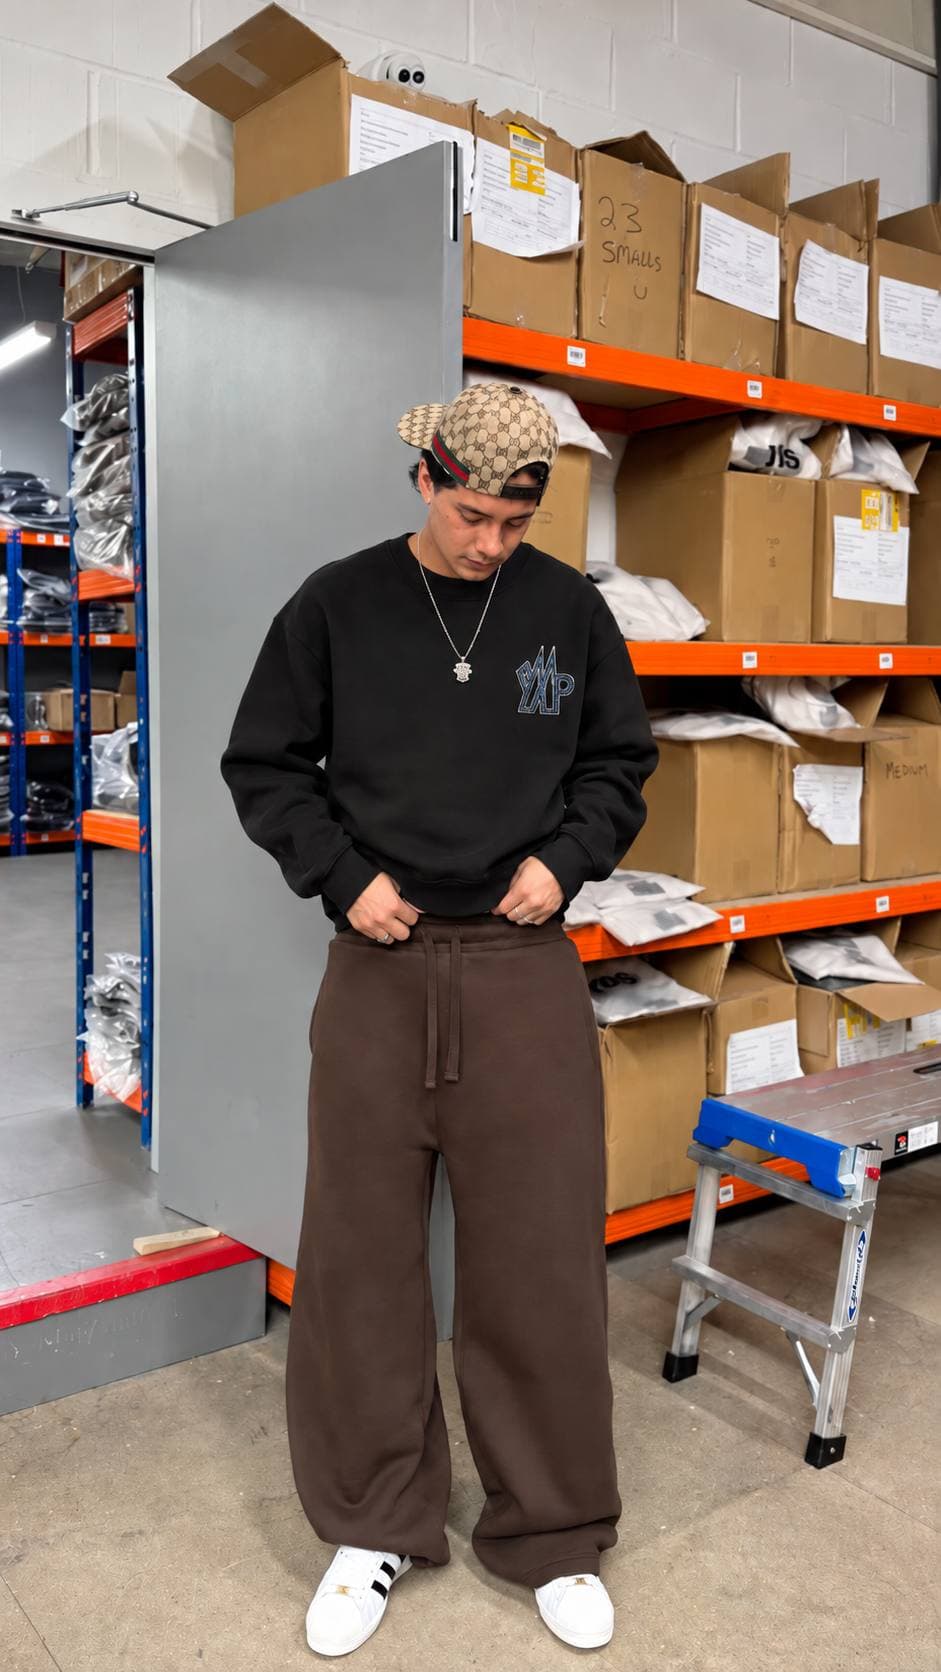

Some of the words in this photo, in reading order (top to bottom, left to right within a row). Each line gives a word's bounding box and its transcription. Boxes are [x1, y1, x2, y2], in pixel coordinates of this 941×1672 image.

[598, 195, 642, 233] 23
[601, 240, 662, 272] SMALLS
[886, 761, 929, 780] MEDIUM
